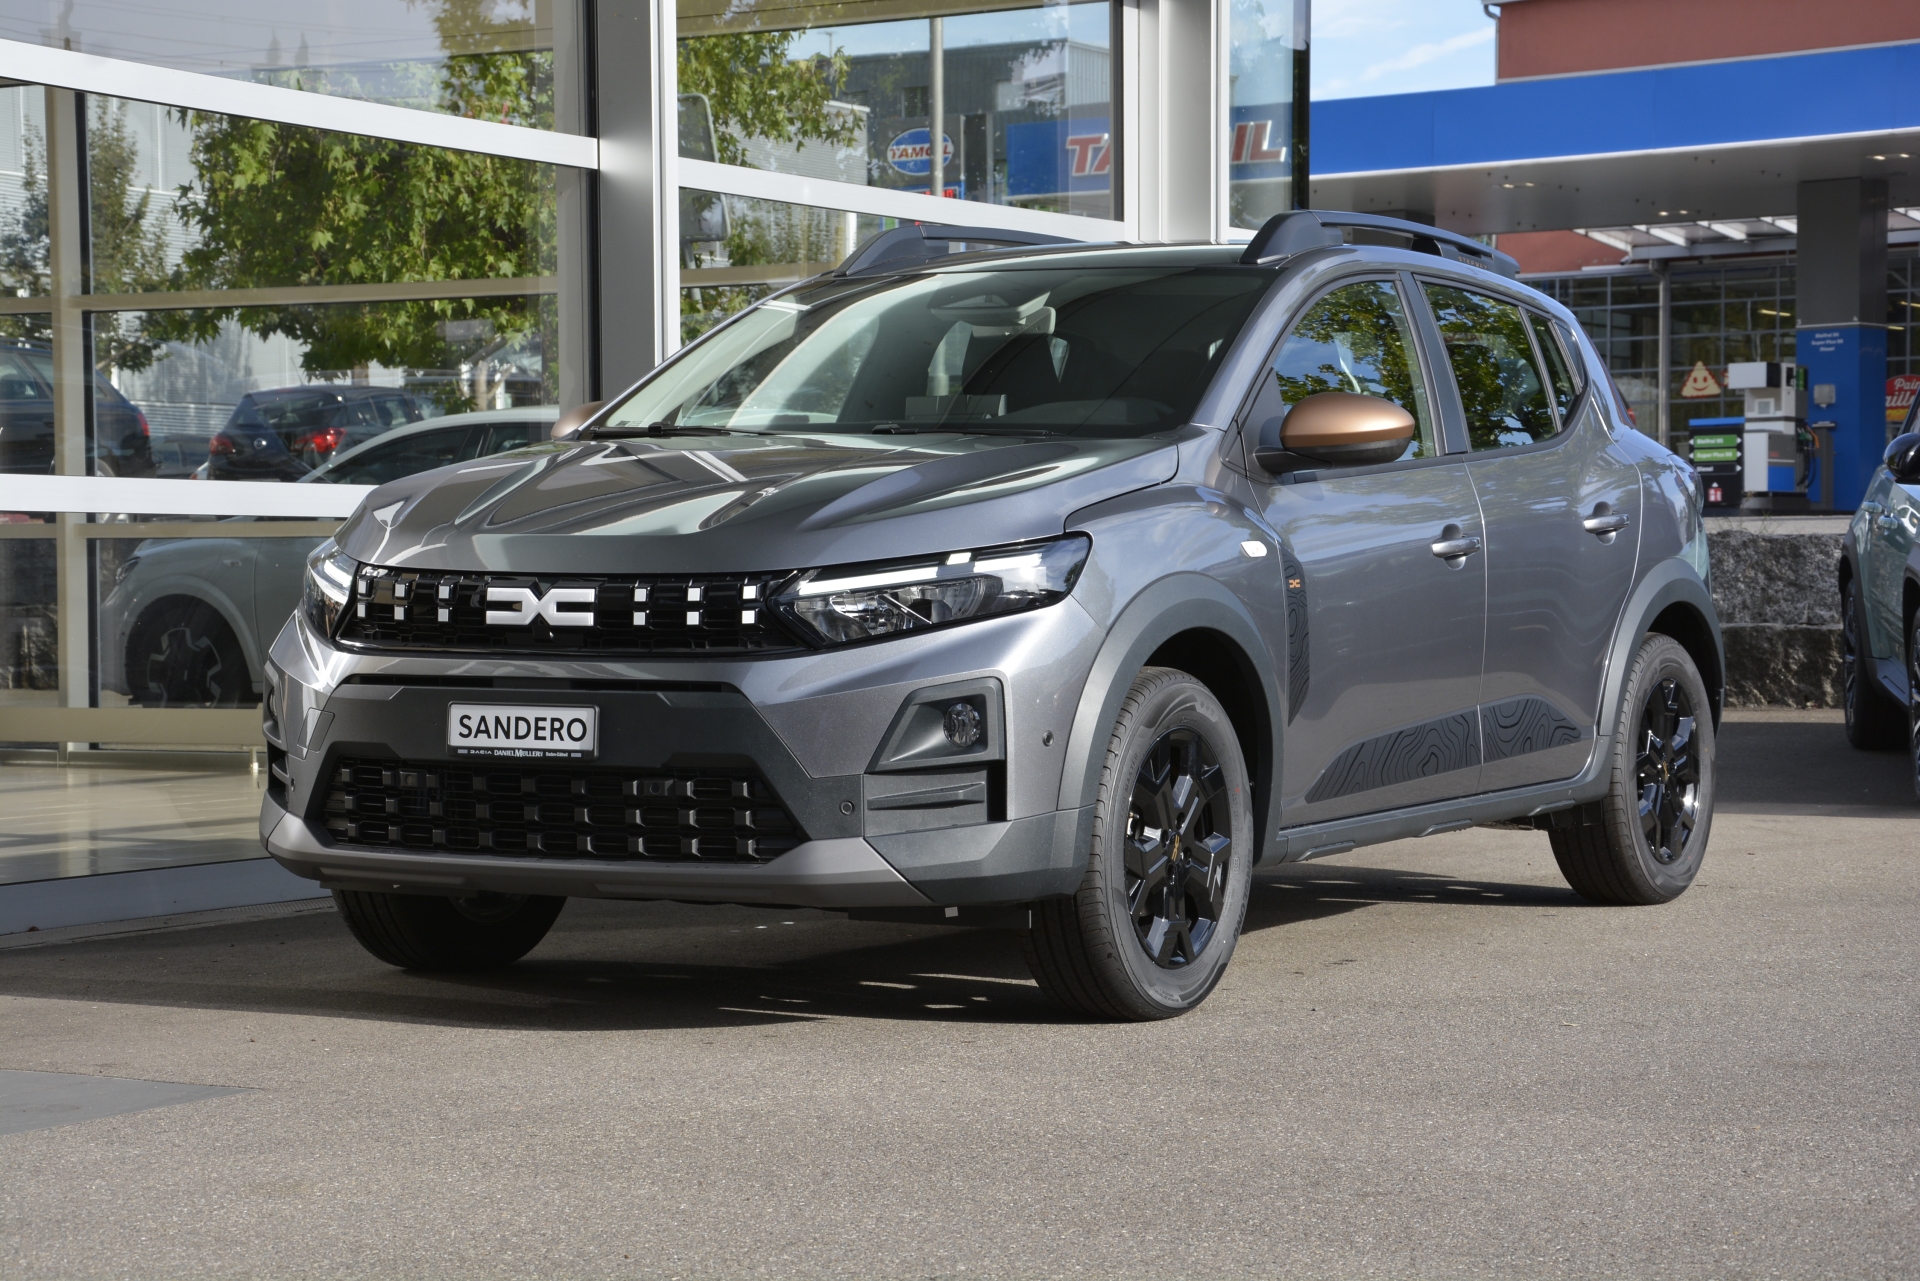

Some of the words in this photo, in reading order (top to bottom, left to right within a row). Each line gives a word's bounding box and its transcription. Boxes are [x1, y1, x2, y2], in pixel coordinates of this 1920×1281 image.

[889, 144, 951, 160] TAML
[1457, 256, 1488, 270] STEPWAY
[458, 714, 587, 742] SANDERO
[1232, 850, 1252, 943] LINGLONG
